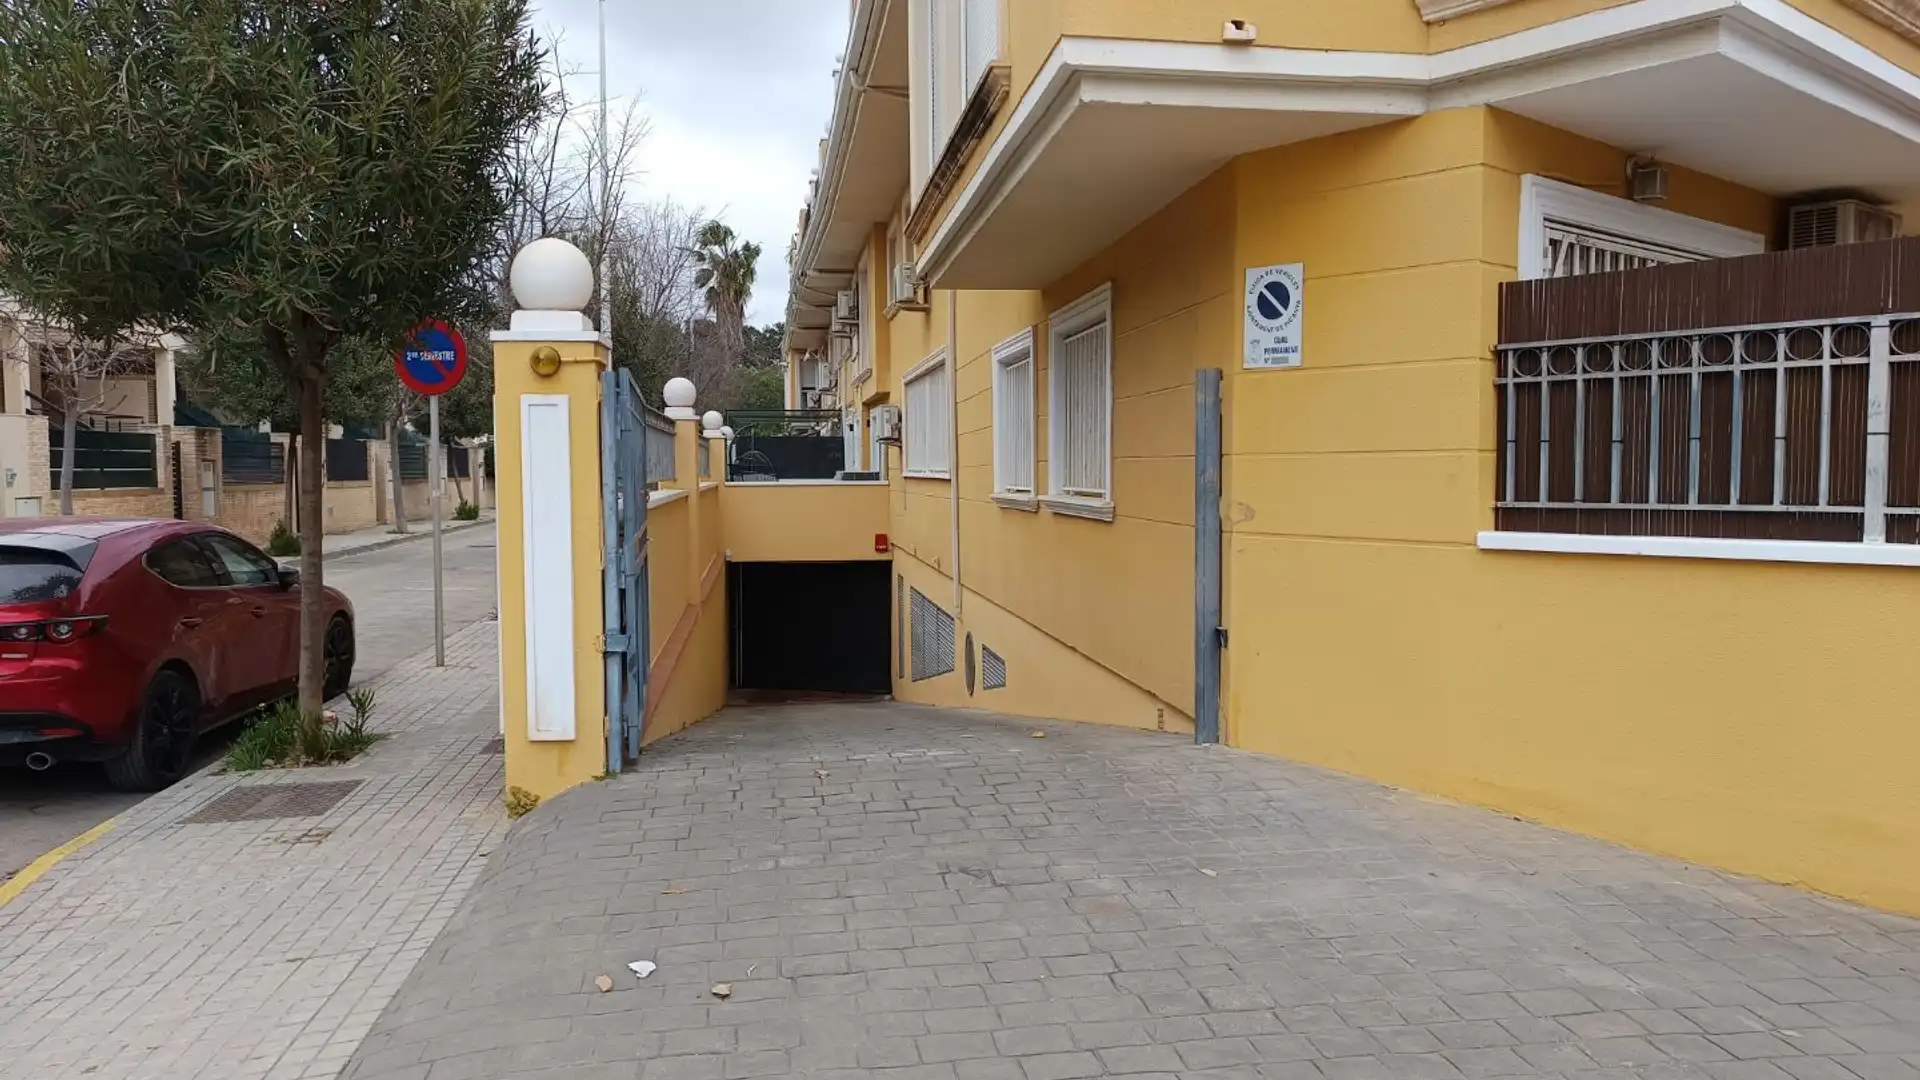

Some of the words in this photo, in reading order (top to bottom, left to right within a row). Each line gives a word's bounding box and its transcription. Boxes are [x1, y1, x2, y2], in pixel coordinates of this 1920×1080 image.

[1275, 324, 1284, 332] DE
[1264, 346, 1298, 355] PERMANENT
[419, 350, 455, 361] SEMESTRE
